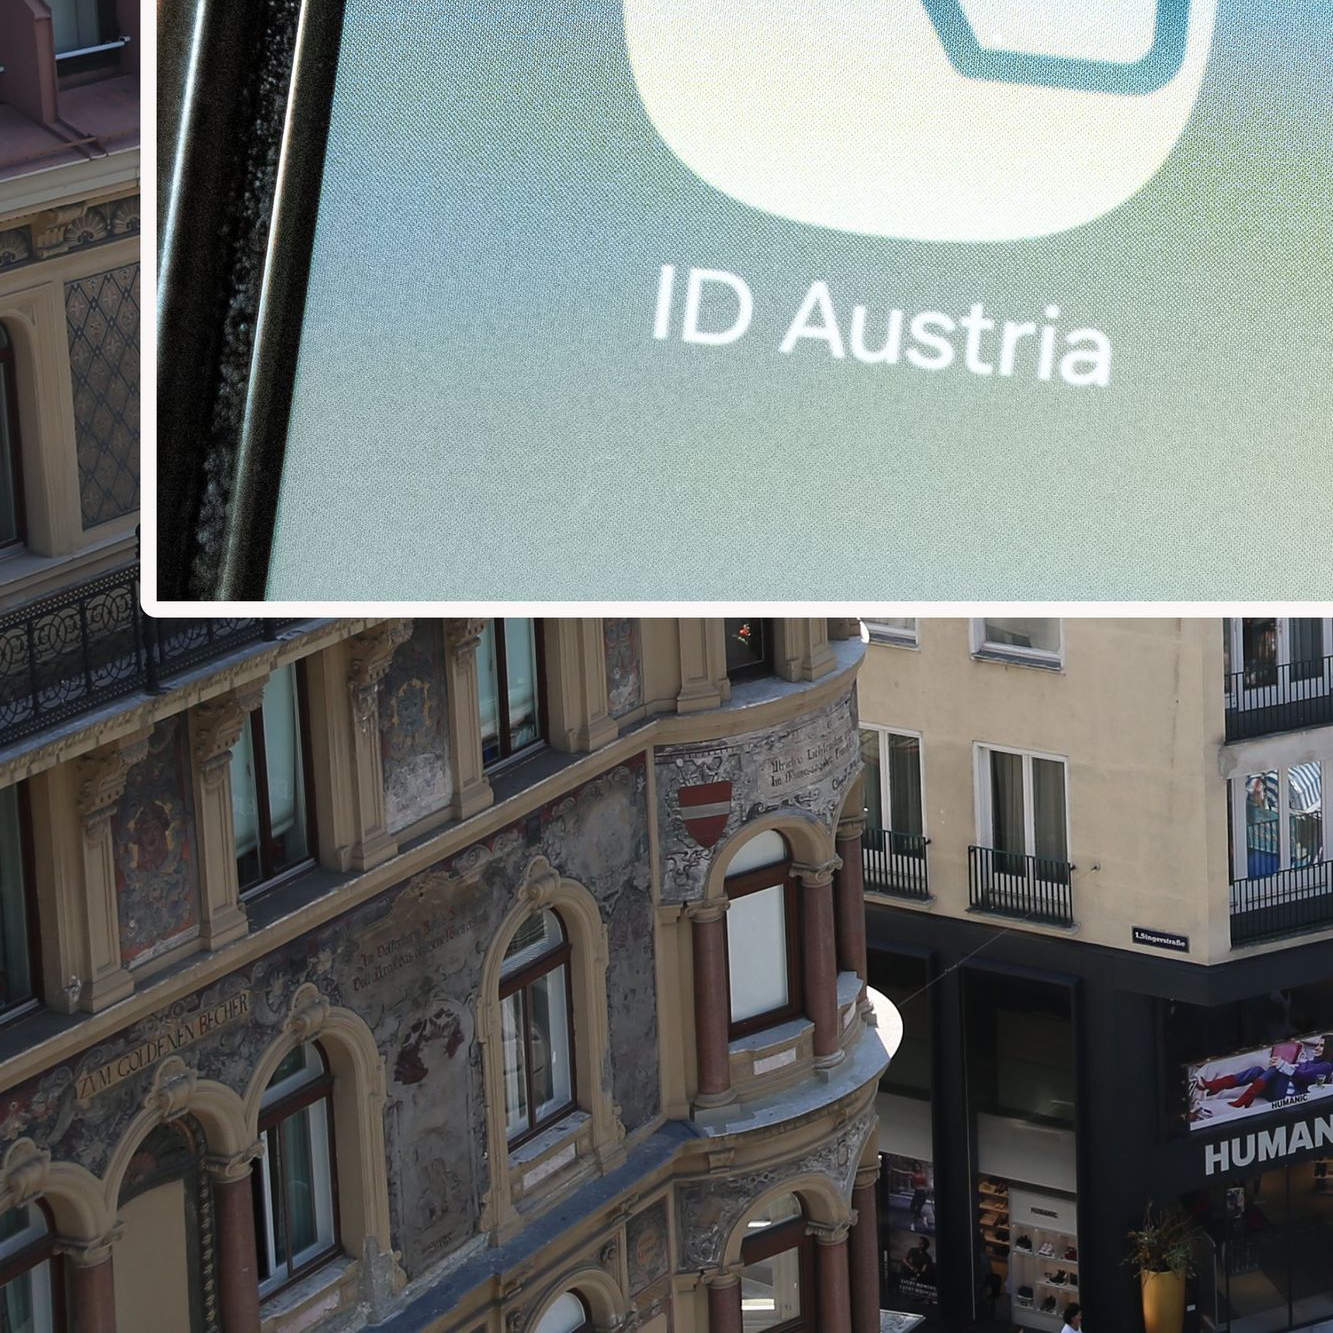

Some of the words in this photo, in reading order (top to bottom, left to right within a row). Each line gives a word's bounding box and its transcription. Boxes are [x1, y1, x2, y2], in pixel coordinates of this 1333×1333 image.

[652, 264, 754, 346] ID
[778, 279, 1113, 387] Austria
[199, 993, 249, 1037] BECHER
[1271, 1094, 1308, 1109] HUMANIC
